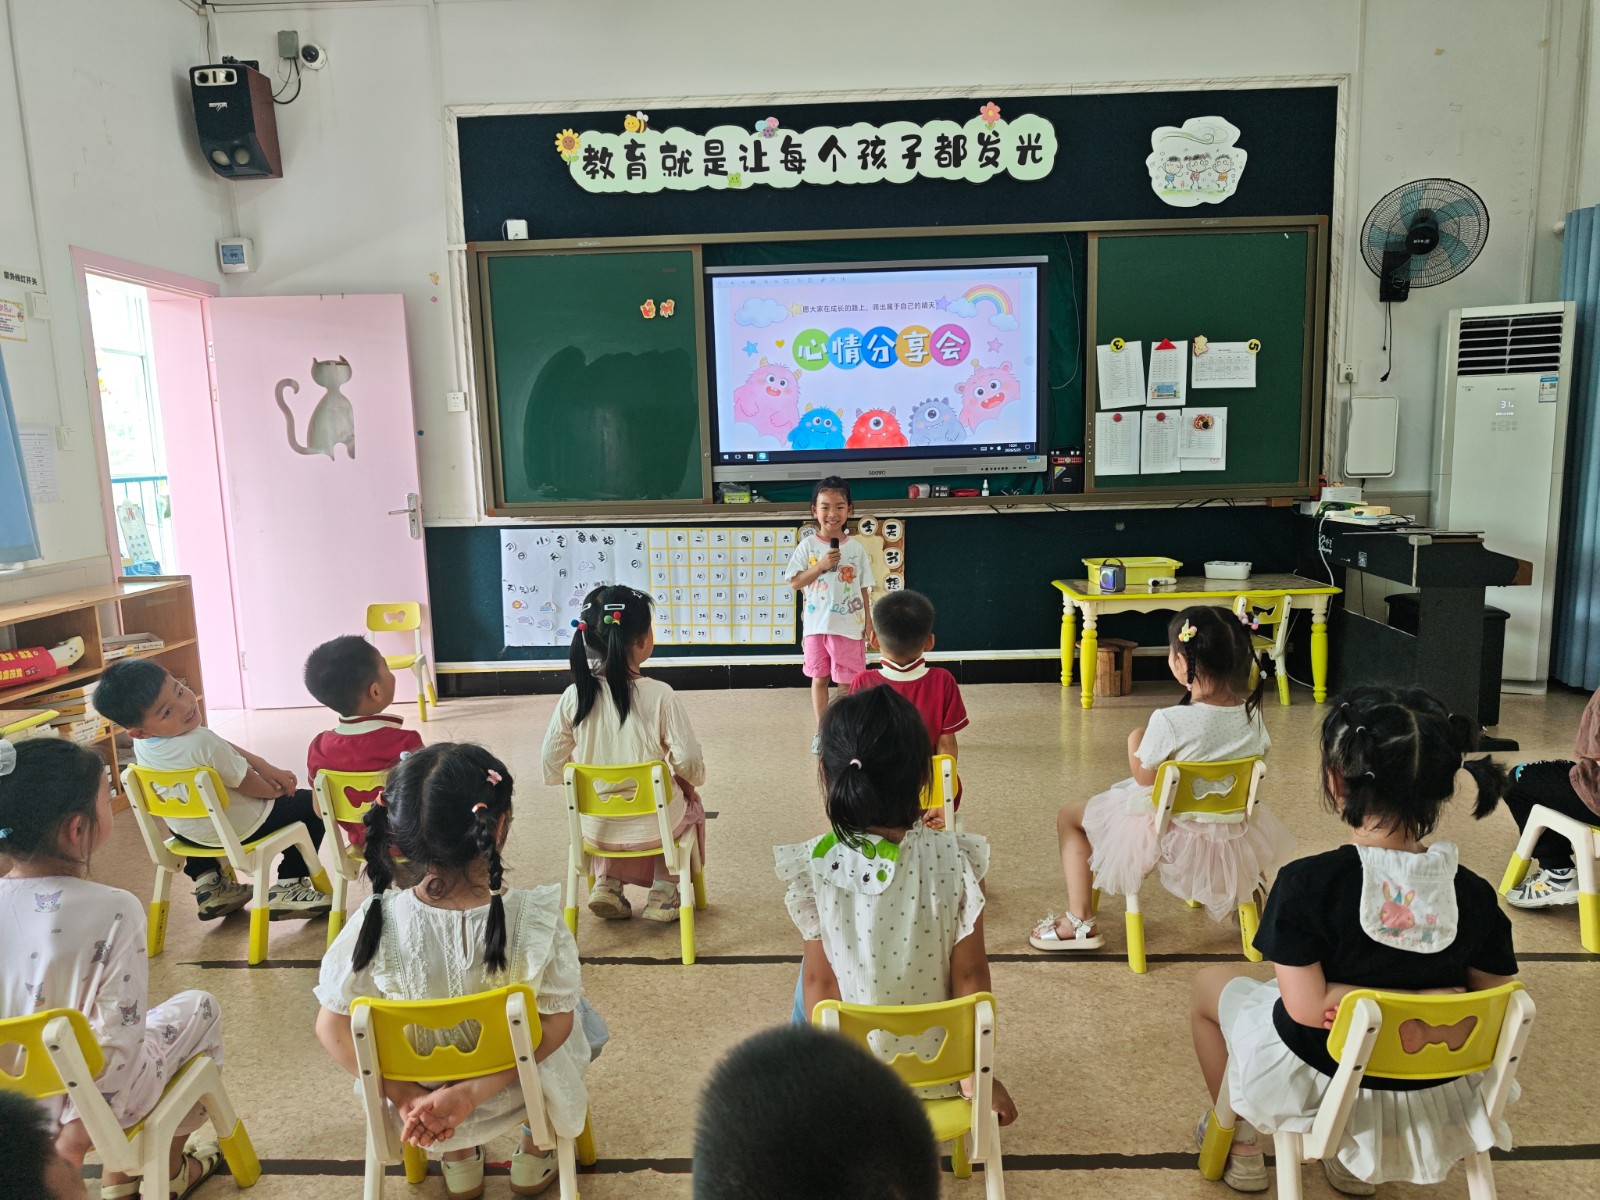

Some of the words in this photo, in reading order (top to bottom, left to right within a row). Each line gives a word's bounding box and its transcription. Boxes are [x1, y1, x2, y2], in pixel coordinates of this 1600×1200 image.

[582, 130, 1043, 181] 教育就是让每个孩子都发光
[798, 330, 966, 365] 心情分享会
